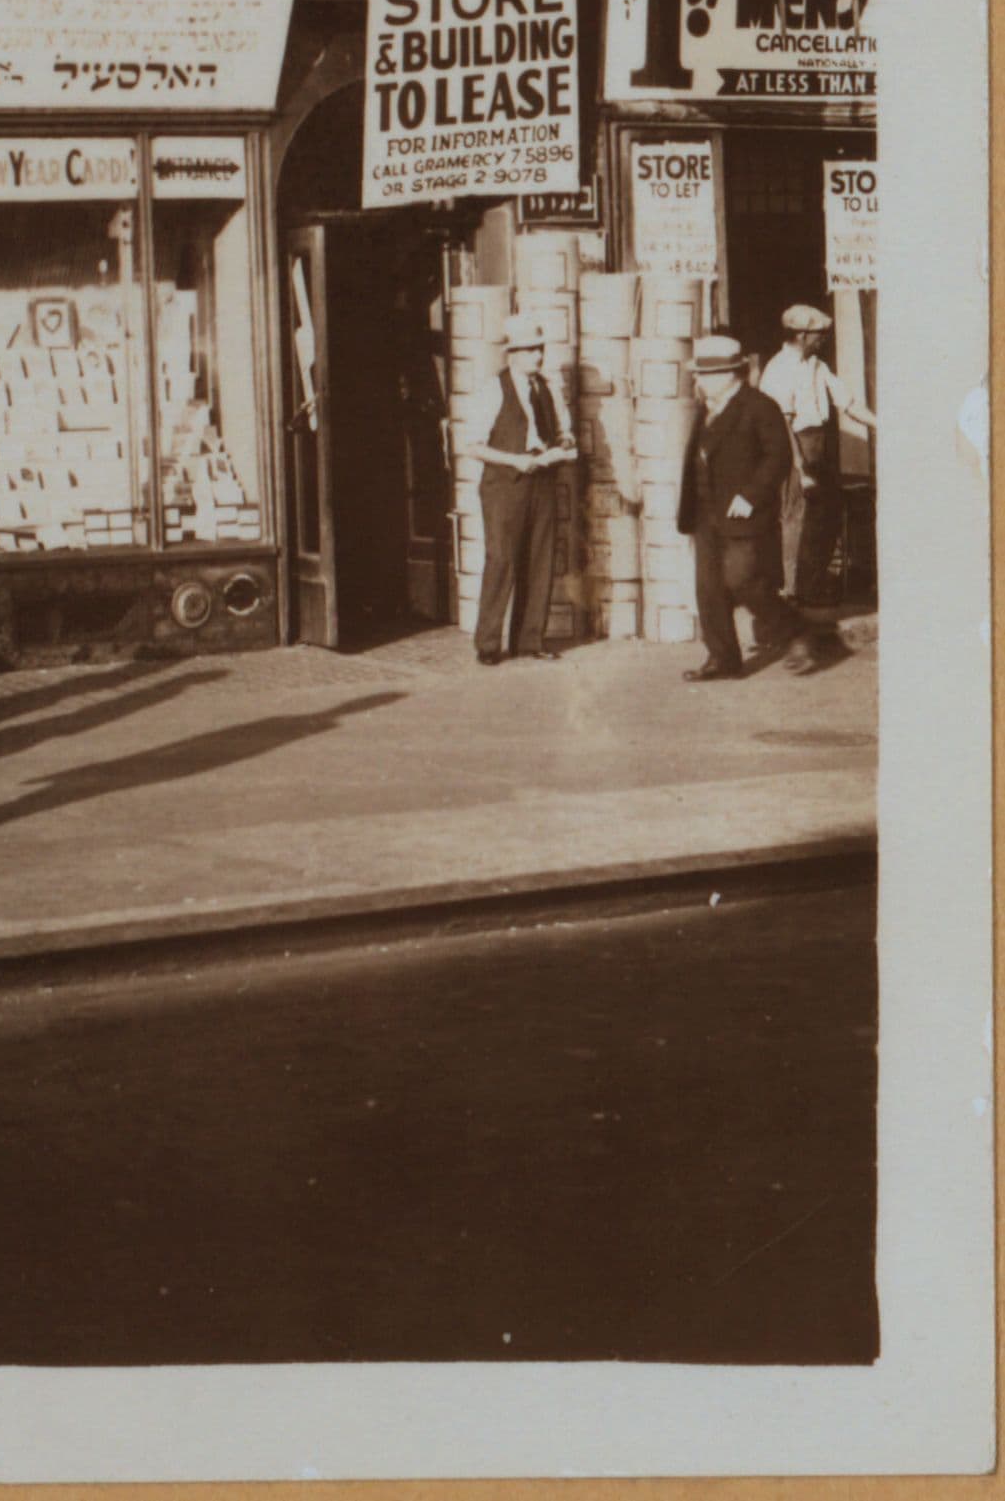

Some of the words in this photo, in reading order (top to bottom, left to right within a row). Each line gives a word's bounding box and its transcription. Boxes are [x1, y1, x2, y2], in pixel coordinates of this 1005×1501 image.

[375, 38, 396, 75] &
[401, 17, 575, 73] BUILDING
[735, 73, 758, 93] AT
[765, 73, 809, 94] LESS
[817, 74, 867, 94] THAN
[375, 79, 427, 132] TO
[434, 65, 572, 127] LEASE
[386, 136, 426, 157] FOR
[431, 123, 561, 151] INFORMATION
[8, 150, 60, 188] YEAR
[372, 163, 408, 180] CALL
[413, 152, 505, 173] GRAMERCY
[510, 148, 520, 165] 7
[524, 145, 574, 165] 5896
[637, 154, 711, 181] STORE
[382, 182, 404, 196] OR
[411, 173, 468, 193] STAGG
[474, 170, 487, 184] 2
[493, 167, 548, 184] 9078
[649, 182, 670, 198] TO
[675, 182, 701, 199] LET
[830, 169, 877, 195] STO
[842, 197, 862, 212] TO
[866, 197, 878, 212] L
